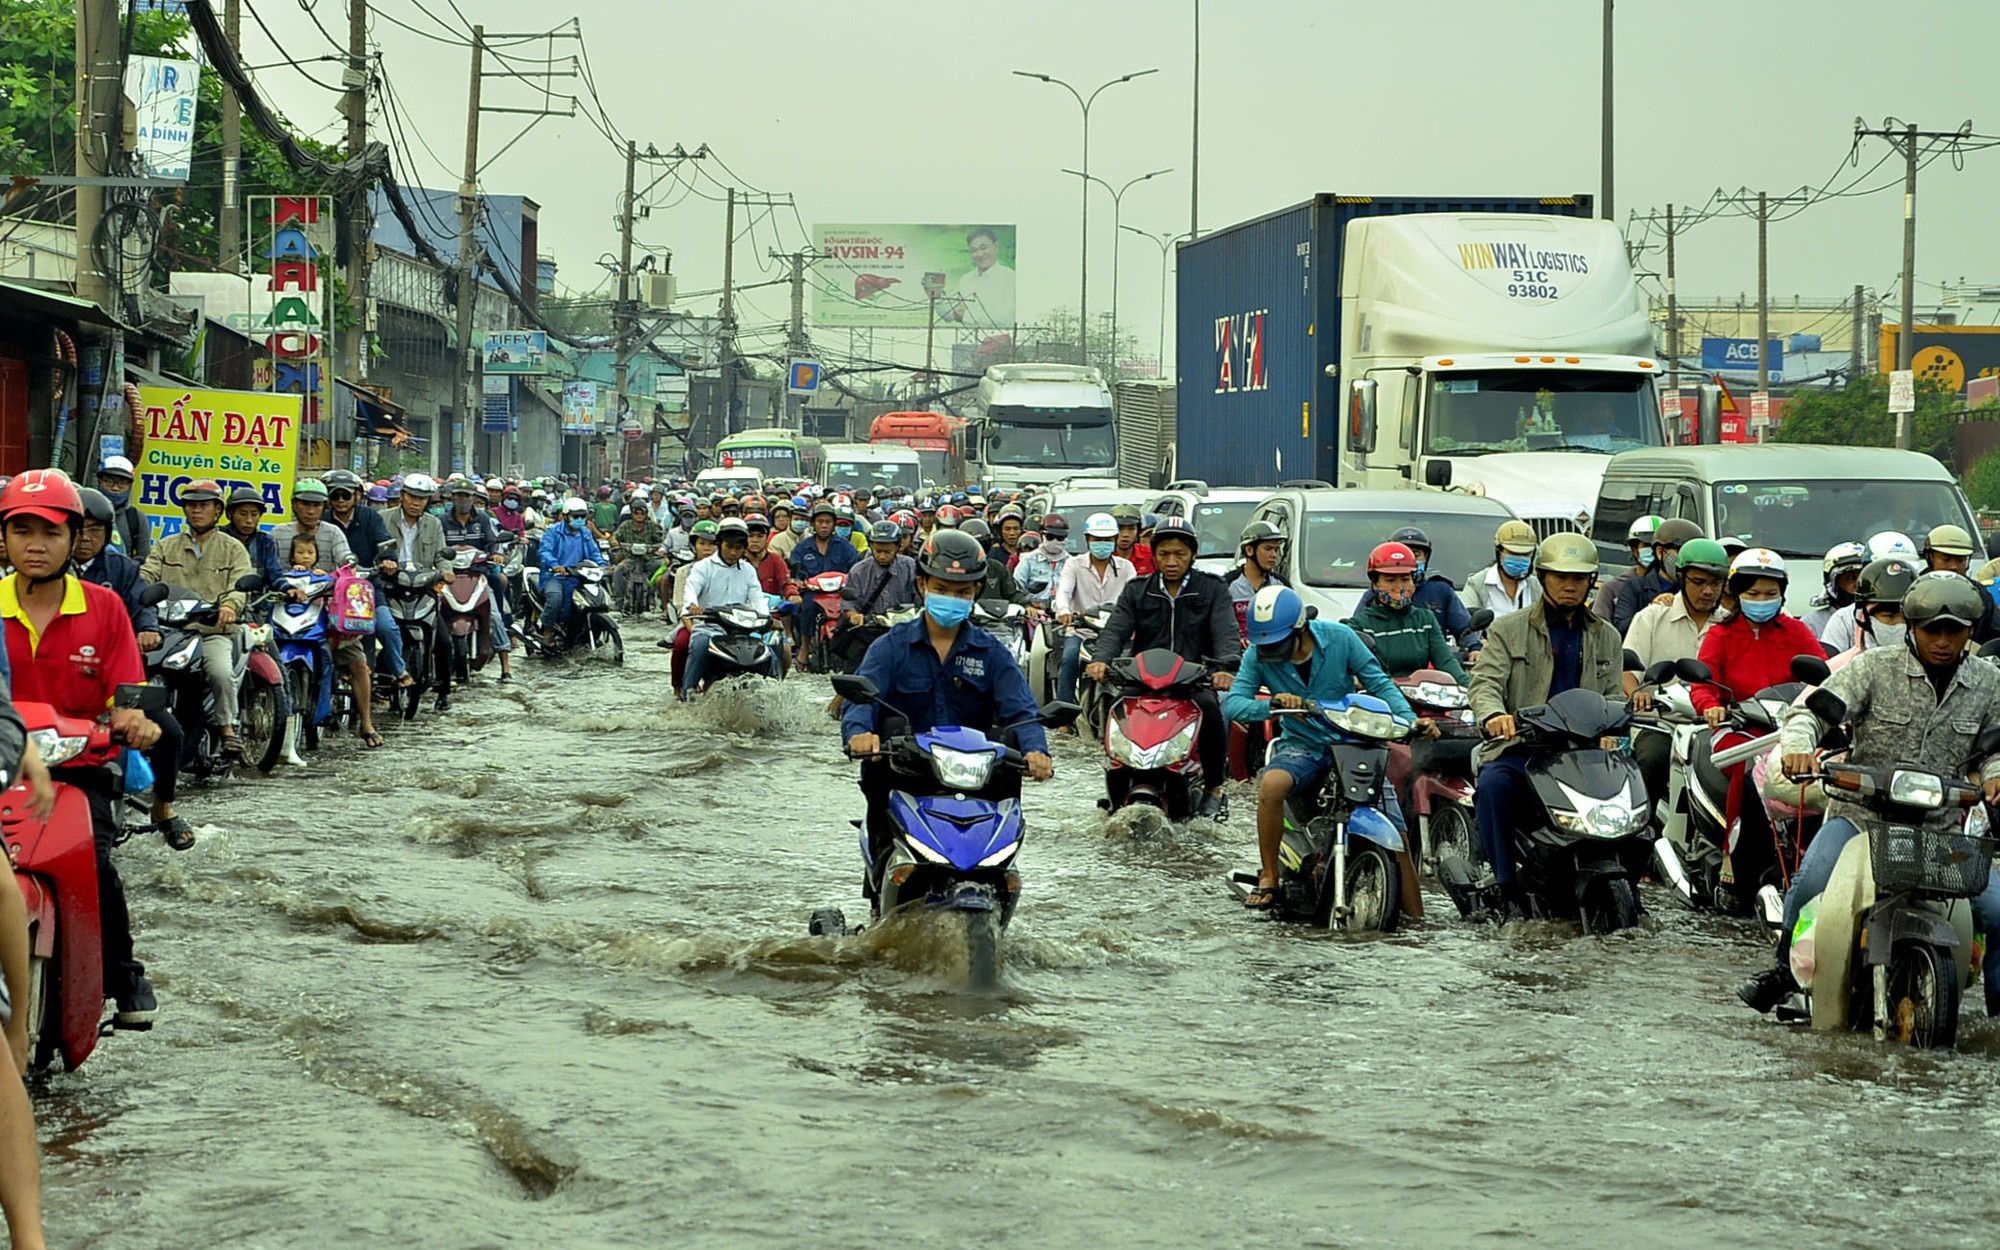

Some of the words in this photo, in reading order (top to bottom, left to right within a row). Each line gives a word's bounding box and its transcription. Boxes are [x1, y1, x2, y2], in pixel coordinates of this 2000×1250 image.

[1458, 243, 1526, 270] WINWAY
[1529, 251, 1588, 274] LOGISTICS
[1513, 271, 1548, 283] 51C
[1508, 284, 1558, 299] 93802
[489, 335, 532, 344] TIFFY
[1725, 343, 1759, 359] ACB
[145, 394, 212, 442] TẤN
[223, 413, 291, 454] ĐẠT
[149, 450, 214, 469] Chuyên
[220, 455, 252, 471] Sửa
[258, 458, 281, 473] Xe
[139, 473, 284, 514] HOA
